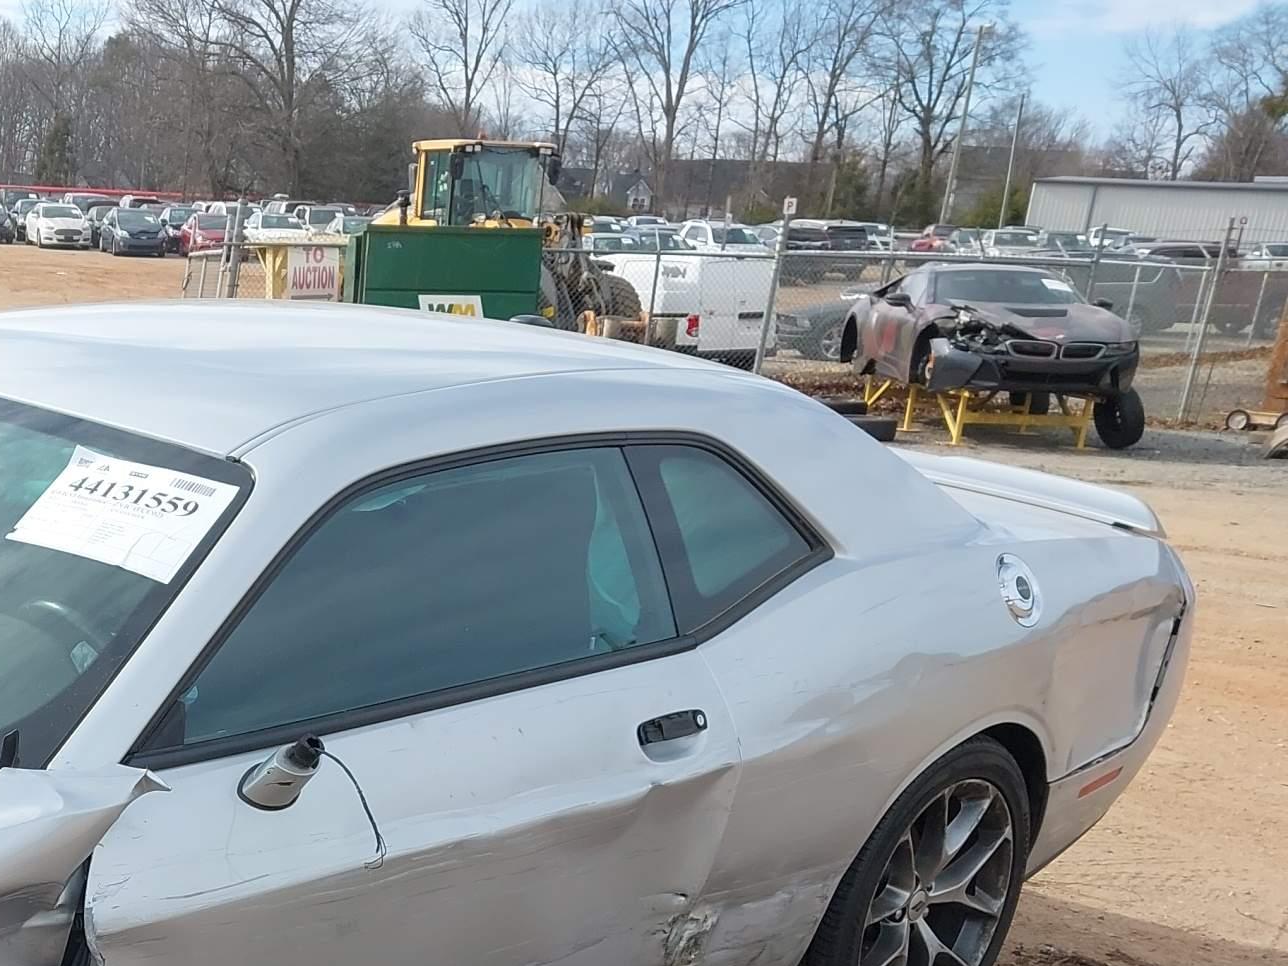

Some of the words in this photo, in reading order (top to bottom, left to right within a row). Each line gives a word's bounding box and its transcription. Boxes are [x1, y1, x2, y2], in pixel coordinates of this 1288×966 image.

[302, 246, 325, 264] TO
[291, 265, 335, 290] AUCTION
[68, 477, 200, 517] 44131559
